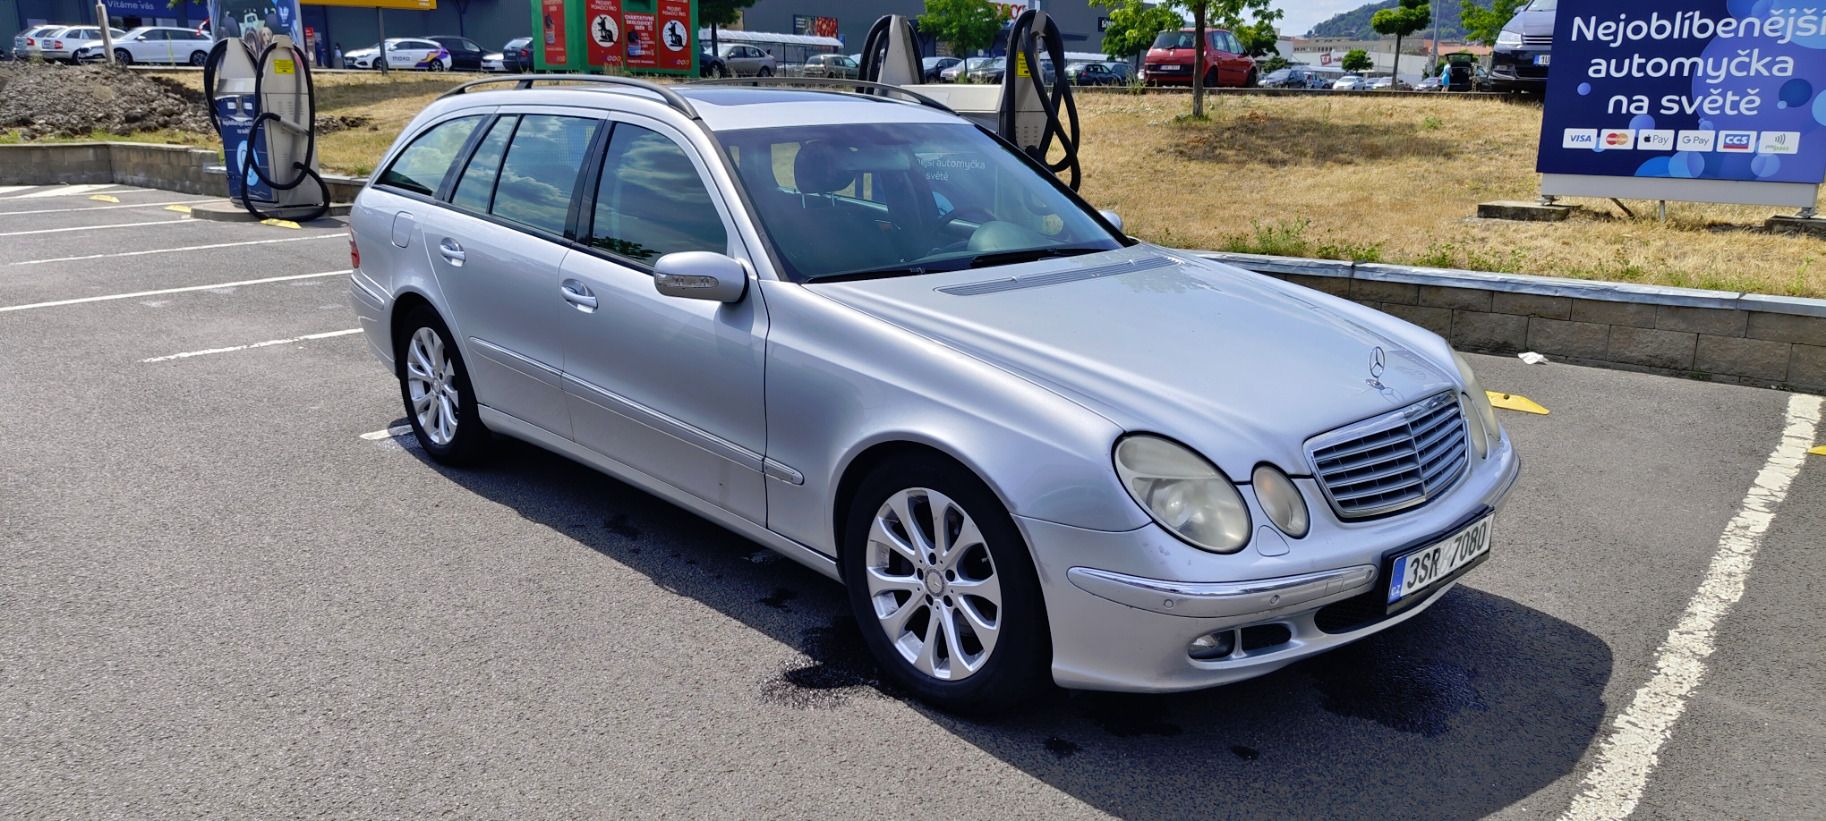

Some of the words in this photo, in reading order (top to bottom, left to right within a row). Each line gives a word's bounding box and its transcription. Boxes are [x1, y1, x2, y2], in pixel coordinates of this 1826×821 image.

[1571, 8, 1826, 47] Nejoblíbenější
[1588, 49, 1794, 83] automyčka
[1608, 95, 1649, 115] na
[1660, 88, 1761, 115] světě
[1652, 135, 1669, 145] Pay
[1693, 137, 1709, 146] Pay
[1725, 136, 1748, 144] CCS
[1407, 548, 1440, 590] 3SR
[1450, 521, 1486, 568] 7080
